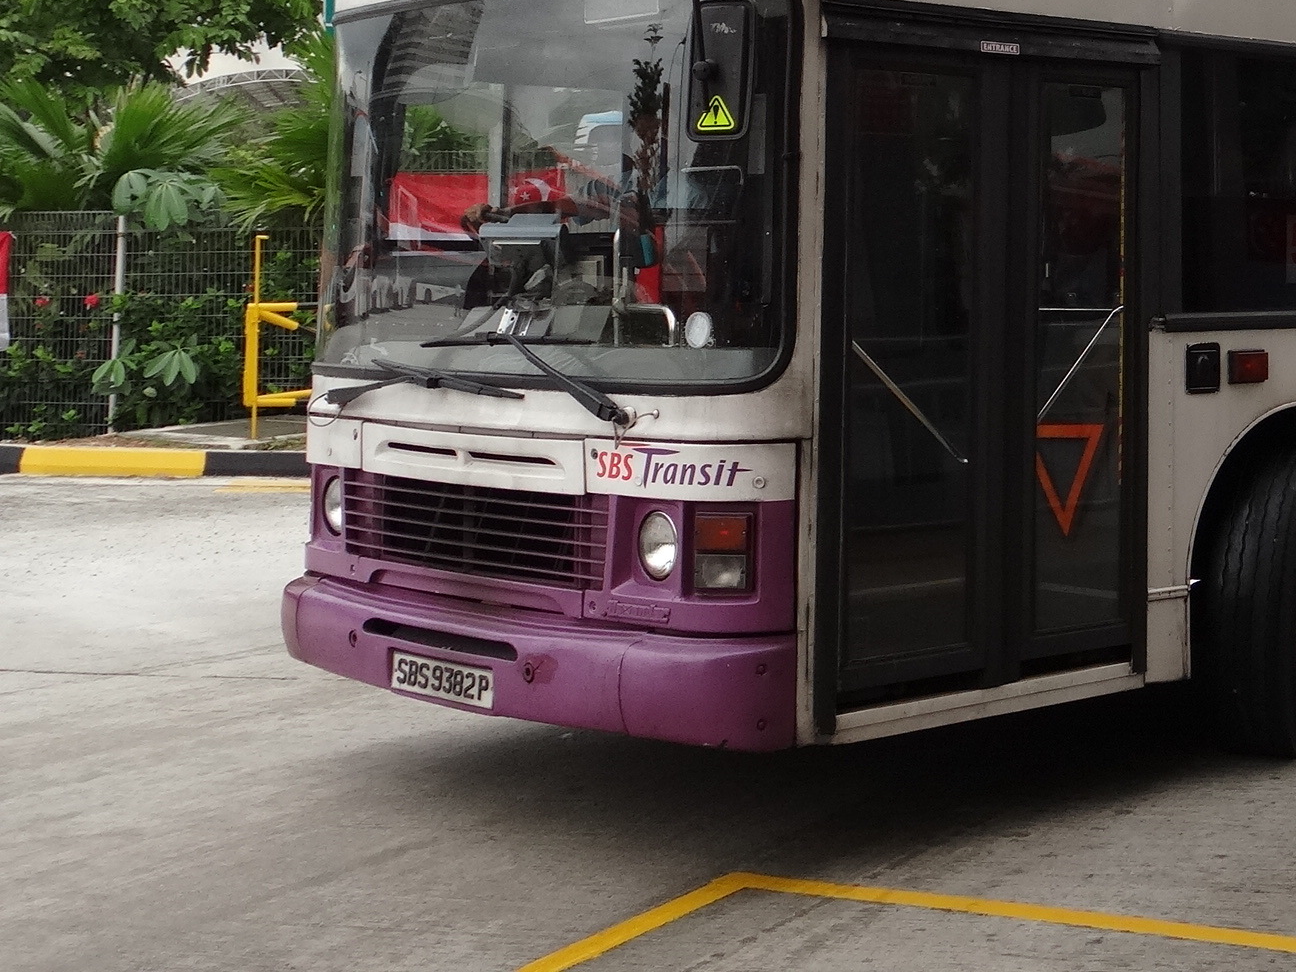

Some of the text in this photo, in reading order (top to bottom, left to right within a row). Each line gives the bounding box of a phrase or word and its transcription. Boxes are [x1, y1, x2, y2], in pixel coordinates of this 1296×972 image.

[983, 43, 1017, 53] ENTRANCE
[596, 448, 753, 488] SBS Transit
[396, 657, 490, 701] SBS9382P
